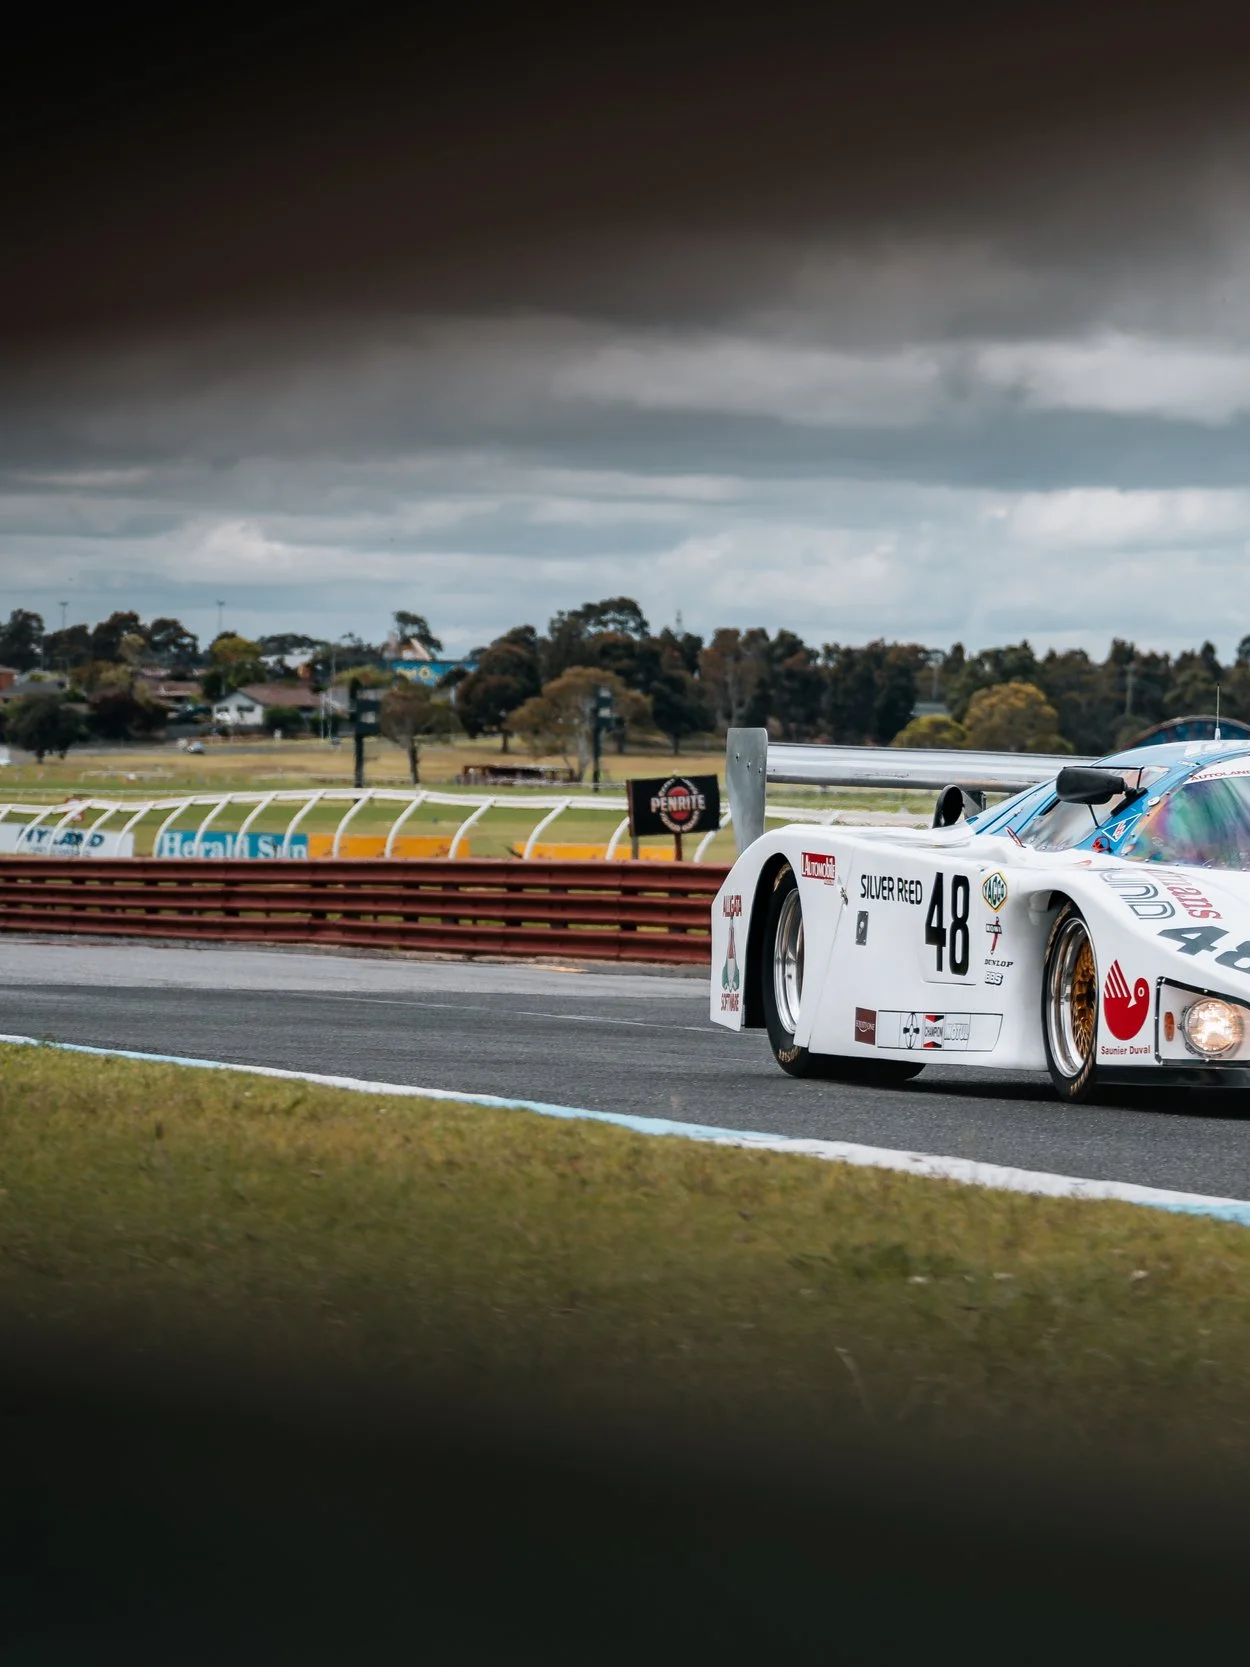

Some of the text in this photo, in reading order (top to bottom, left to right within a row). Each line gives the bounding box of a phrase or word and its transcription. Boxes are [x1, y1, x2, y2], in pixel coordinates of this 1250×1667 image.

[650, 794, 706, 814] PENRITE
[161, 832, 309, 860] Herald Sun
[860, 874, 923, 905] SILVER REED
[925, 871, 970, 976] 48
[984, 958, 1014, 967] DUNLOP
[1101, 1045, 1151, 1055] Saunier Duval
